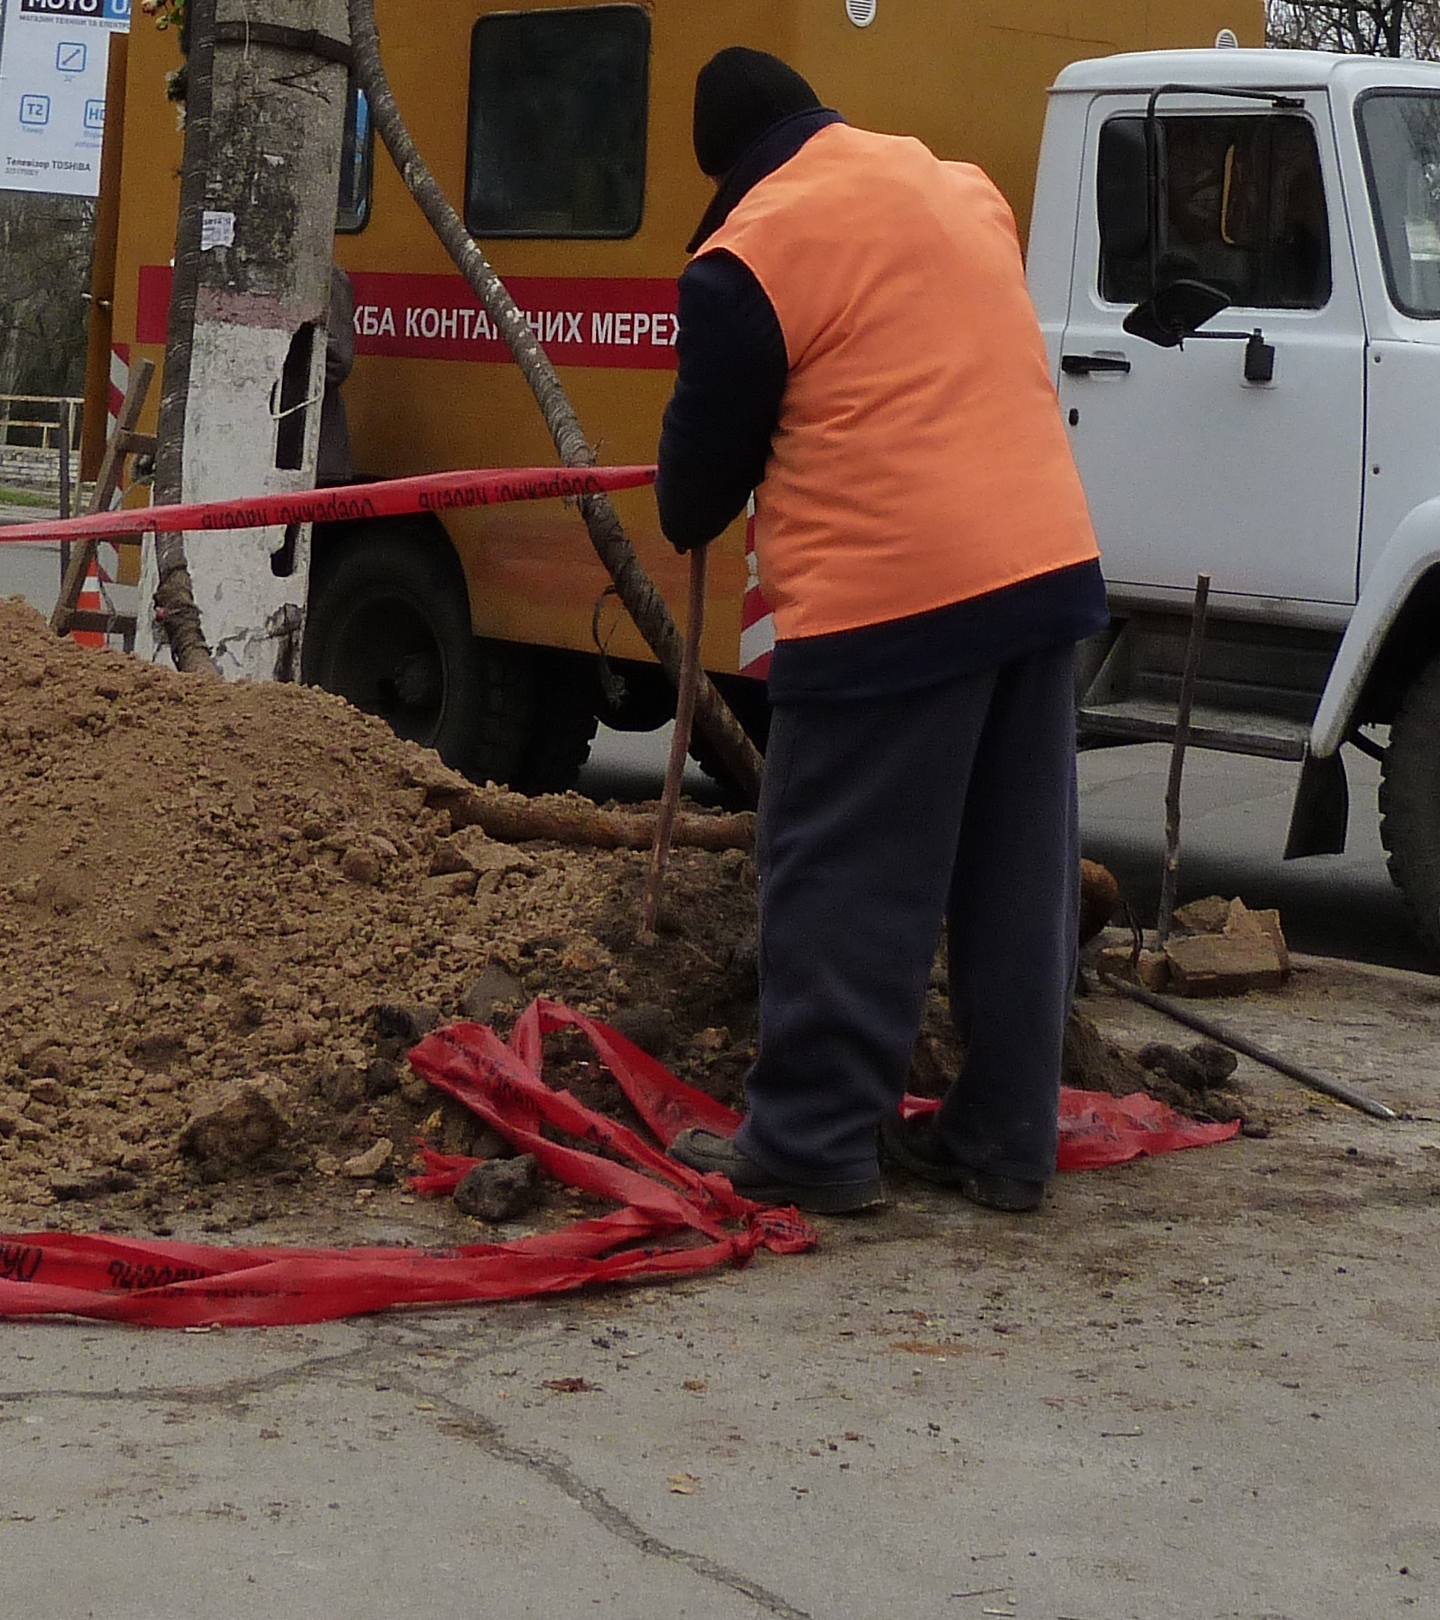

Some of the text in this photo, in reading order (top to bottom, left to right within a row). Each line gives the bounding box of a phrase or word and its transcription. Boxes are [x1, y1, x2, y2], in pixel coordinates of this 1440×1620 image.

[26, 103, 43, 116] T2
[52, 160, 92, 171] TOSHIBA
[405, 307, 582, 343] КОНТАНИХ
